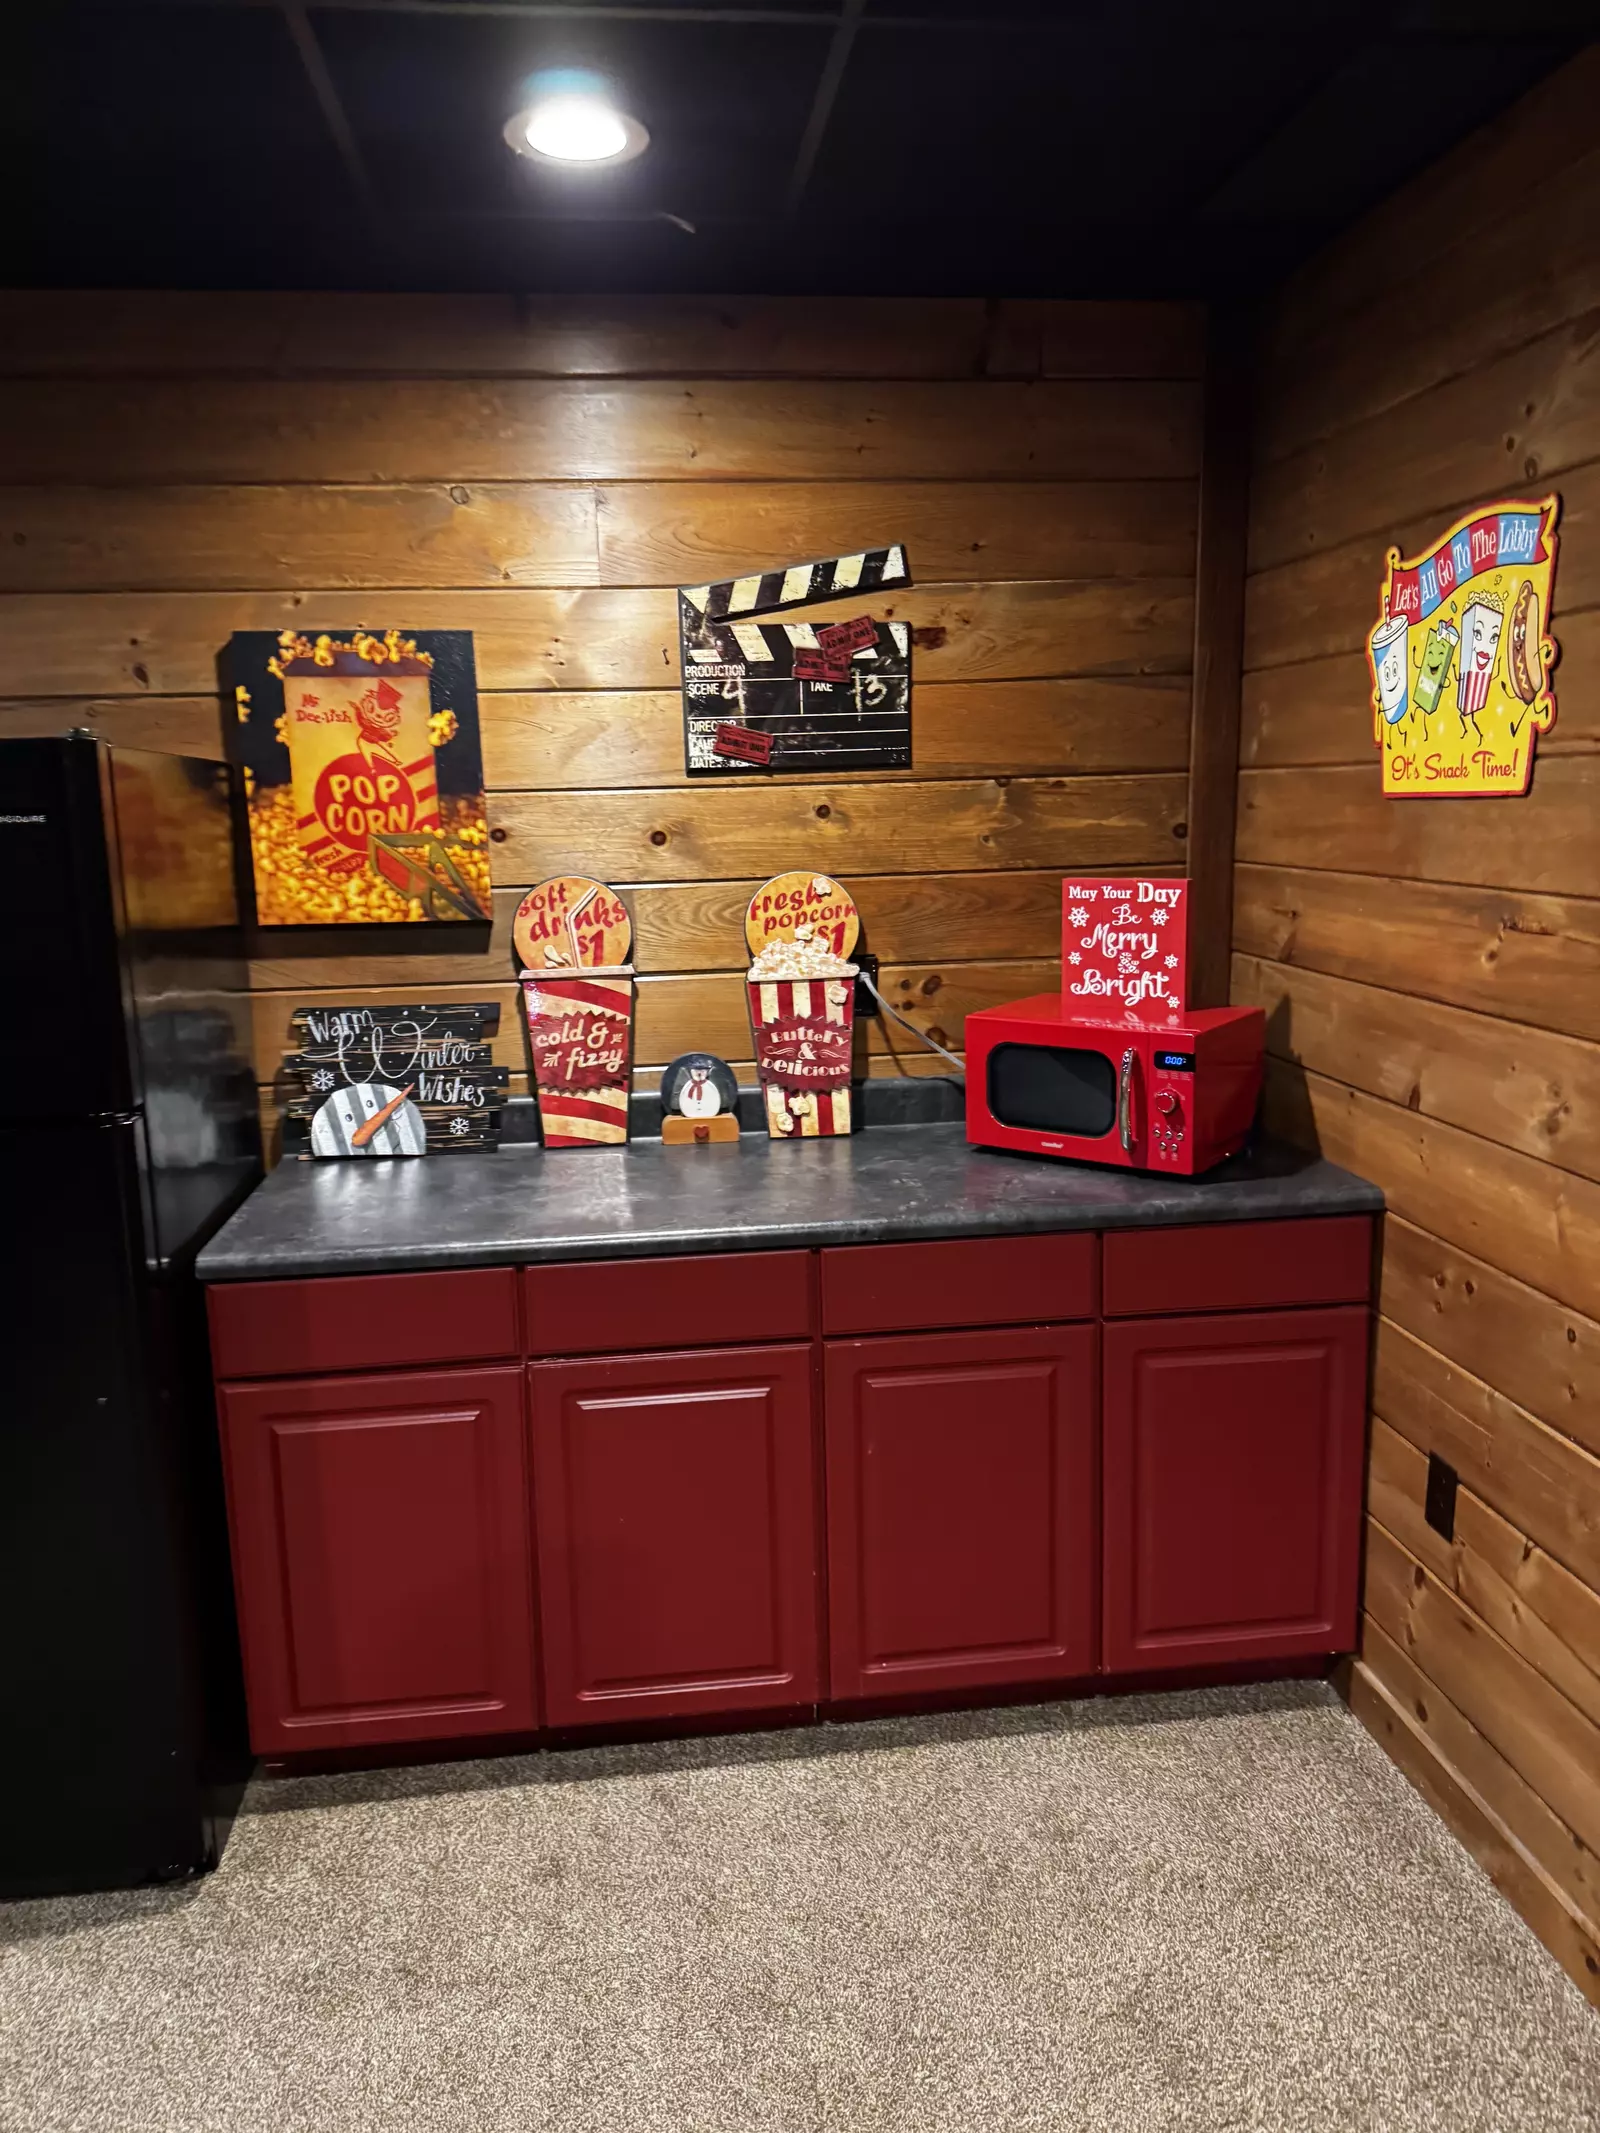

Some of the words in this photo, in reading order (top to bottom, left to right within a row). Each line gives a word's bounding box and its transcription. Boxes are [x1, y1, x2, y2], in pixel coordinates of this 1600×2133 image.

[1394, 583, 1419, 612] Let's
[1420, 572, 1438, 603] All
[1437, 559, 1454, 589] Go
[1453, 543, 1471, 575] To
[1472, 527, 1497, 563] The
[1497, 518, 1540, 560] Lobby
[684, 662, 746, 678] PRODUCTION
[810, 680, 833, 693] TAKE
[687, 682, 720, 697] SCENE
[1391, 753, 1421, 781] It's
[1425, 752, 1470, 781] Snack
[1471, 748, 1519, 780] Time!
[328, 774, 401, 805] POP
[326, 803, 409, 836] CORN
[518, 882, 568, 918] soft
[1068, 885, 1099, 902] May
[1101, 885, 1133, 899] Your
[1137, 882, 1182, 908] Day
[529, 896, 629, 943] drinks
[763, 903, 857, 937] popcorn
[1111, 903, 1142, 926] Be
[1080, 923, 1158, 960] Merry
[1117, 952, 1140, 974] &
[1069, 968, 1171, 1007] Bright
[307, 1009, 375, 1044] Warm
[536, 1017, 585, 1048] cold
[586, 1021, 610, 1050] &
[301, 1017, 476, 1085] Winter
[565, 1047, 625, 1081] fizzy
[797, 1042, 817, 1060] &
[419, 1071, 485, 1107] Wishes
